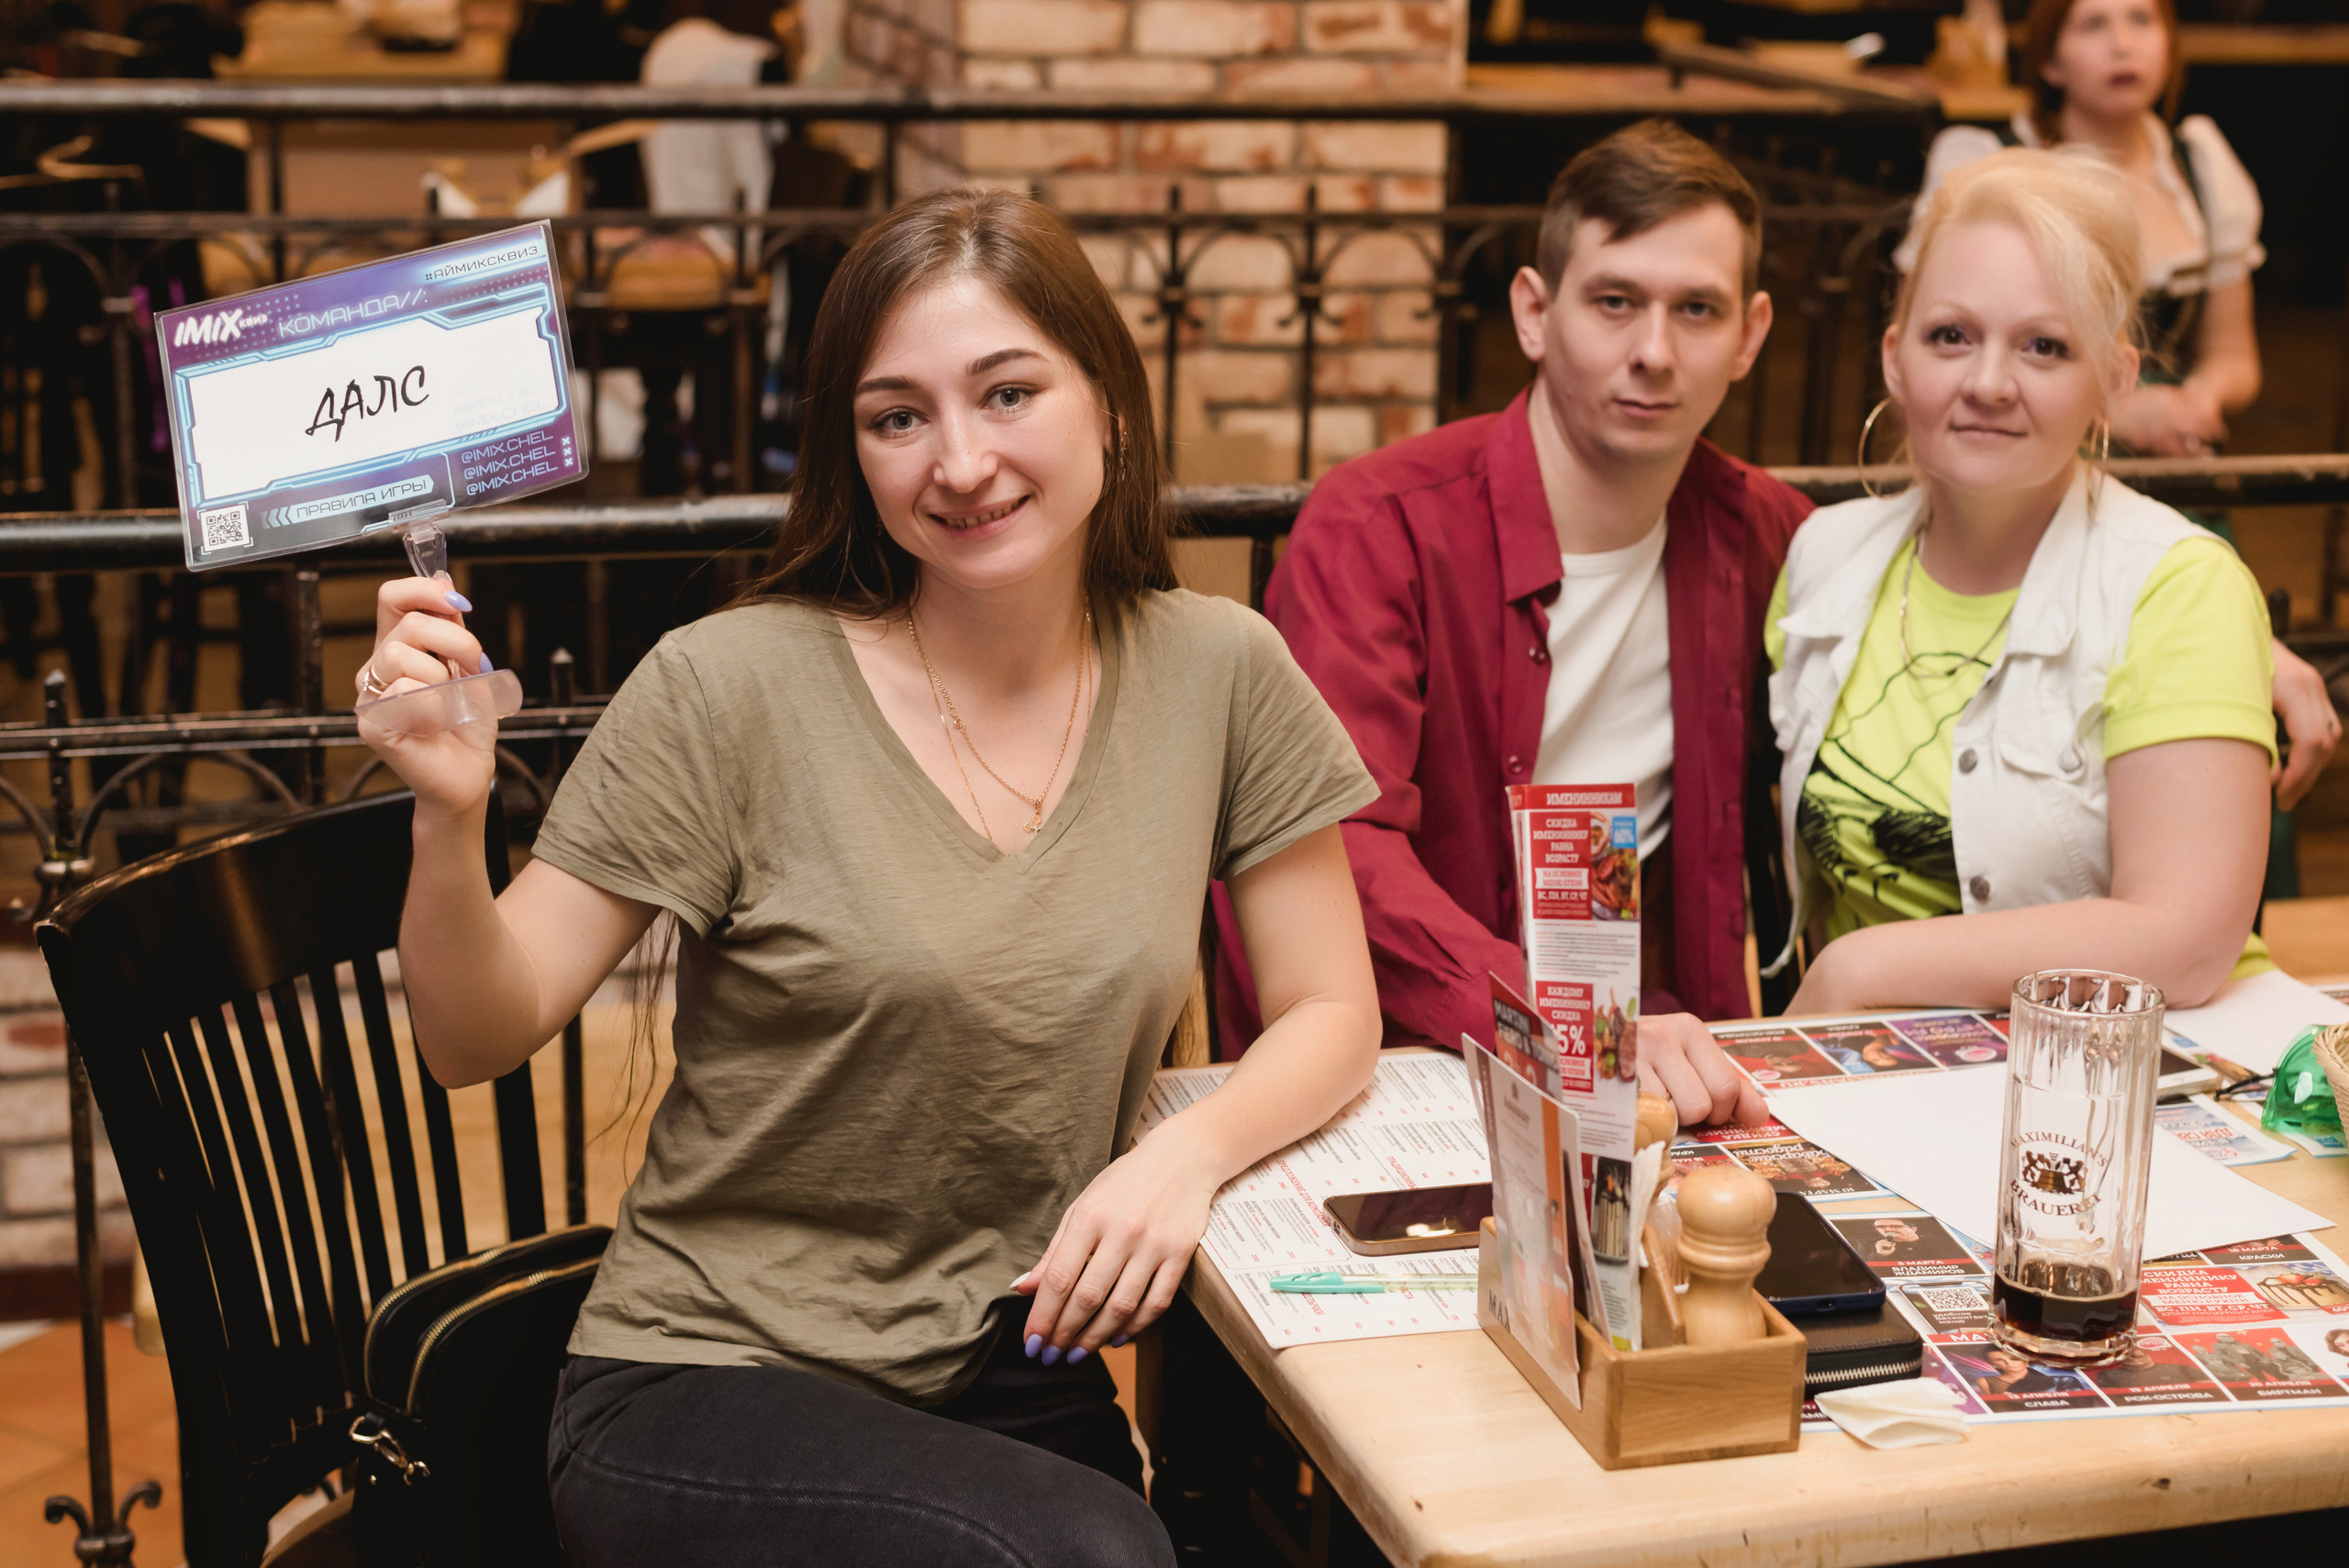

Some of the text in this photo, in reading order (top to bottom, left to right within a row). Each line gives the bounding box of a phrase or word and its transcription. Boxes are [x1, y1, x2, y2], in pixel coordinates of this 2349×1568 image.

[425, 245, 539, 281] #АЙМИКСКВИЗ
[173, 308, 243, 347] IMIX
[305, 364, 429, 442] ДАЛС
[461, 429, 553, 463] @IMIX.CHEL
[463, 446, 556, 480] @IMIX.CHEL
[466, 462, 558, 495] @IMIX.CHEL
[296, 479, 427, 518] ПРАВИЛА ИГРЫ
[1386, 1156, 1418, 1189] ТРАДИЦИОНН
[2240, 1244, 2278, 1253] МАРТА
[2239, 1252, 2285, 1262] КРАСКИ
[2143, 1269, 2209, 1278] СКИДКА
[2140, 1274, 2238, 1284] МЕНИННИКУ
[2156, 1286, 2229, 1295] ВОЗРАСТУ
[2145, 1384, 2191, 1392] АПРЕЛЯ
[2257, 1388, 2321, 1396] БИРТМАН
[2021, 1391, 2070, 1399] АПРЕЛЯ
[2124, 1392, 2214, 1403] РОК-ОСТРОВА
[2024, 1399, 2070, 1407] СЛАВА
